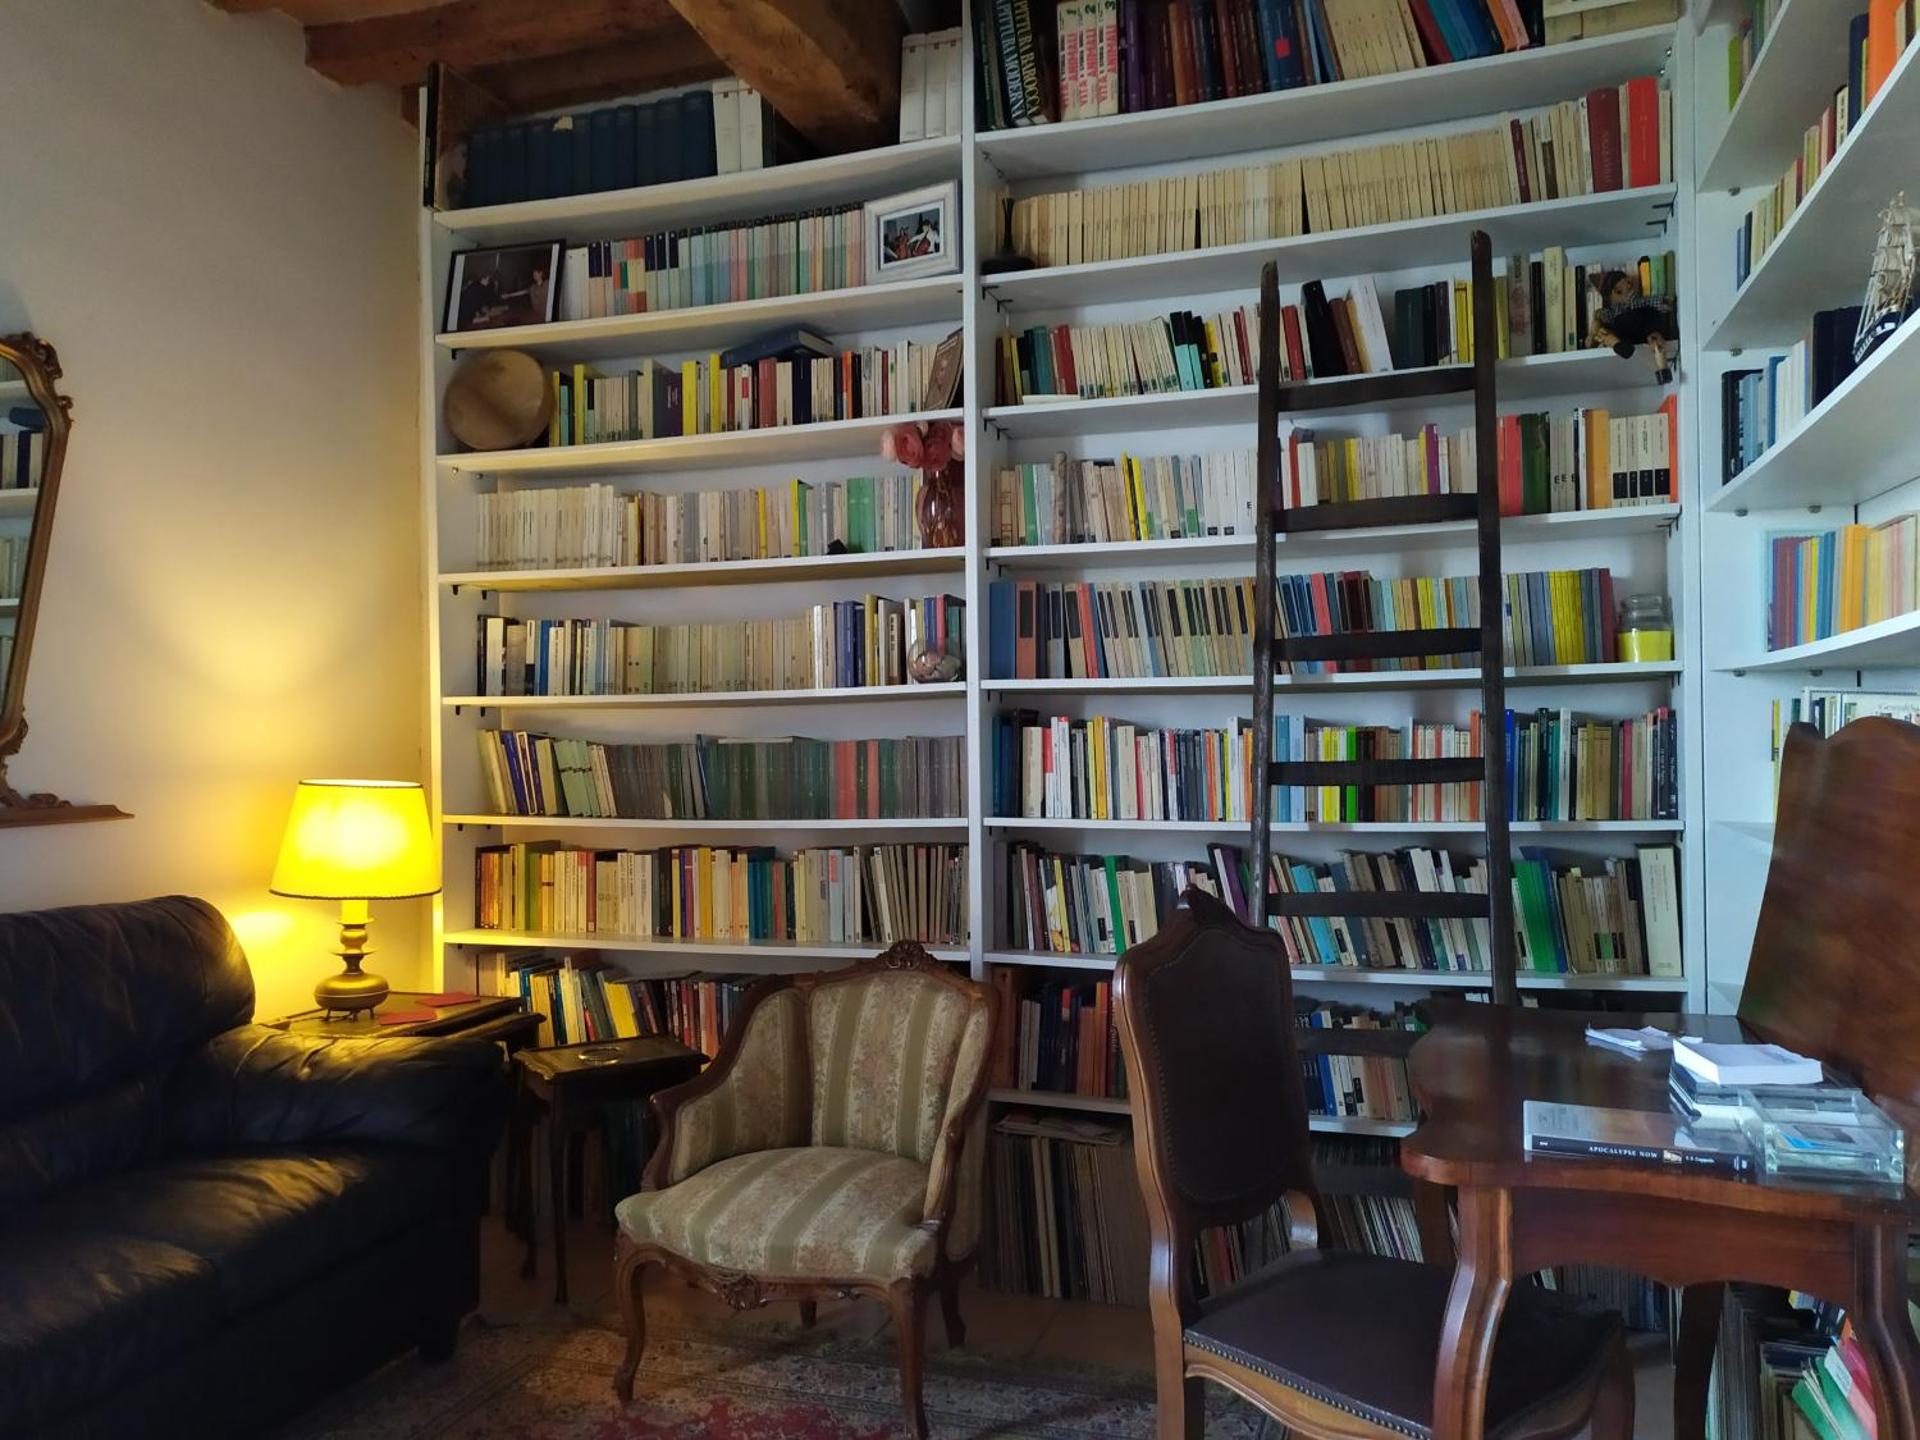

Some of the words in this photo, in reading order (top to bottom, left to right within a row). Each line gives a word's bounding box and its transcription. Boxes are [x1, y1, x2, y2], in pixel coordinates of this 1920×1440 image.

[1085, 4, 1096, 15] 2
[1104, 1, 1116, 11] 3
[1066, 32, 1079, 81] ANIMALI
[1085, 27, 1098, 77] ANIMALI
[1105, 24, 1117, 73] ANIMALI
[1004, 51, 1026, 119] MODERNA
[1021, 51, 1041, 116] BAROCCA
[1079, 79, 1089, 107] VITA
[1097, 74, 1108, 104] VITA
[1588, 1146, 1637, 1157] APOCALYPSE
[1639, 1151, 1658, 1159] NOW
